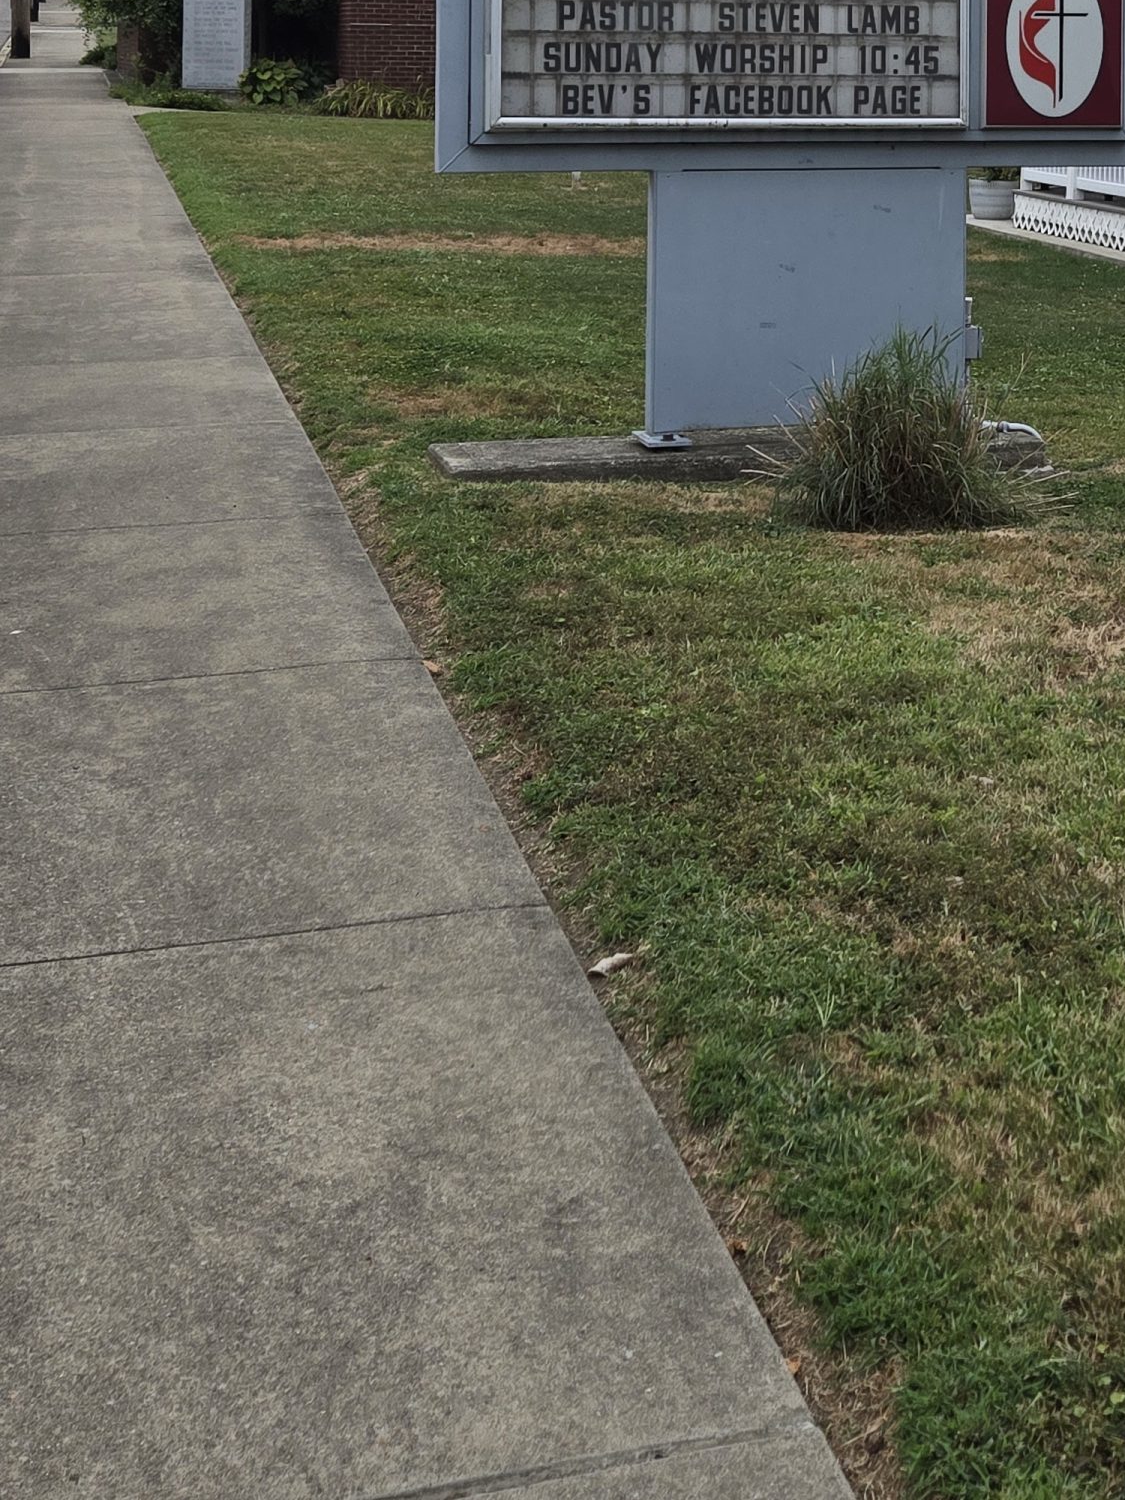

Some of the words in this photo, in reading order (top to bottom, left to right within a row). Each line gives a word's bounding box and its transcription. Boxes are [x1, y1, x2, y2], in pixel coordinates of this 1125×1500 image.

[558, 0, 675, 31] PASTOR
[718, 3, 820, 33] STEVEN
[847, 5, 920, 35] LAMB
[543, 42, 662, 73] SUNDAY
[695, 44, 828, 75] WORSHIP
[860, 45, 940, 75] 10:45
[562, 84, 651, 115] BEV'S
[690, 85, 833, 115] FACEBOOK
[856, 86, 922, 115] PAGE
